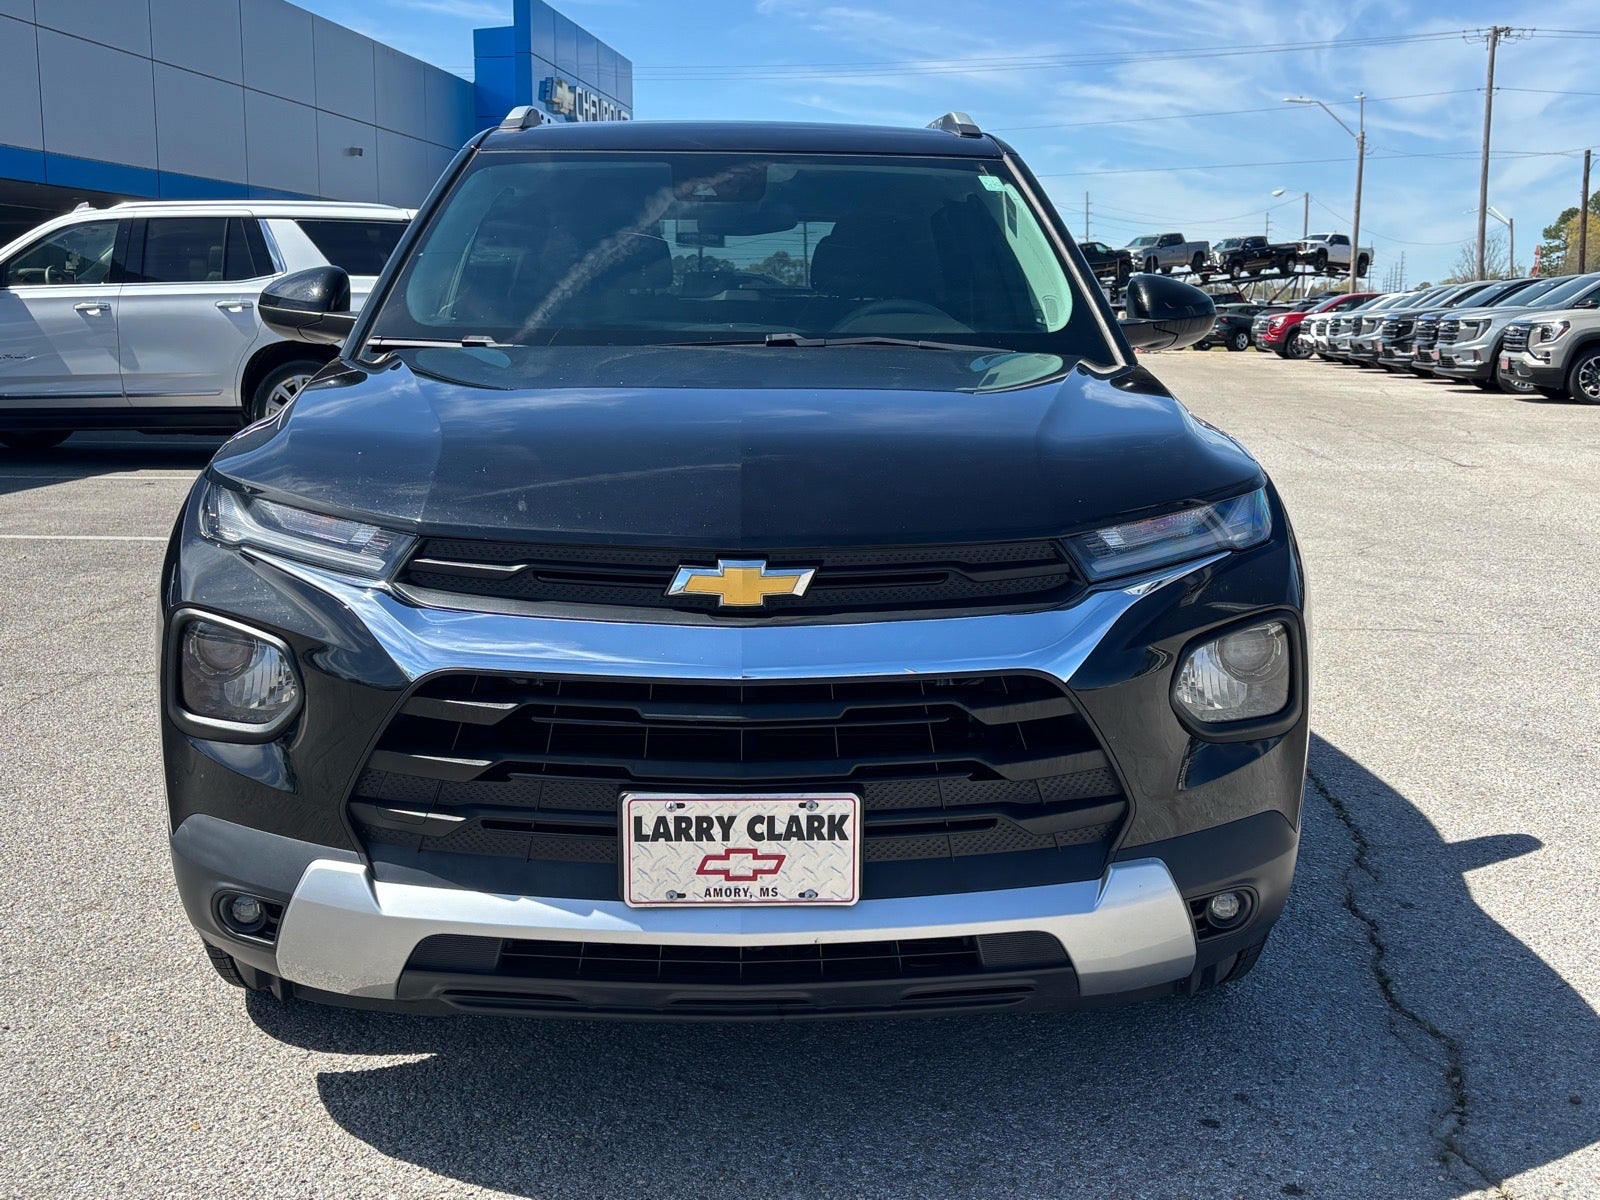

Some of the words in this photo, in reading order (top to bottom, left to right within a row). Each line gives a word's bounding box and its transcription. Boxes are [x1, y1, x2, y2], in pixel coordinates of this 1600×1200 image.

[633, 815, 736, 843] LARRY
[746, 814, 850, 842] CLARK
[704, 887, 753, 899] AMORY,
[759, 887, 779, 898] MS
